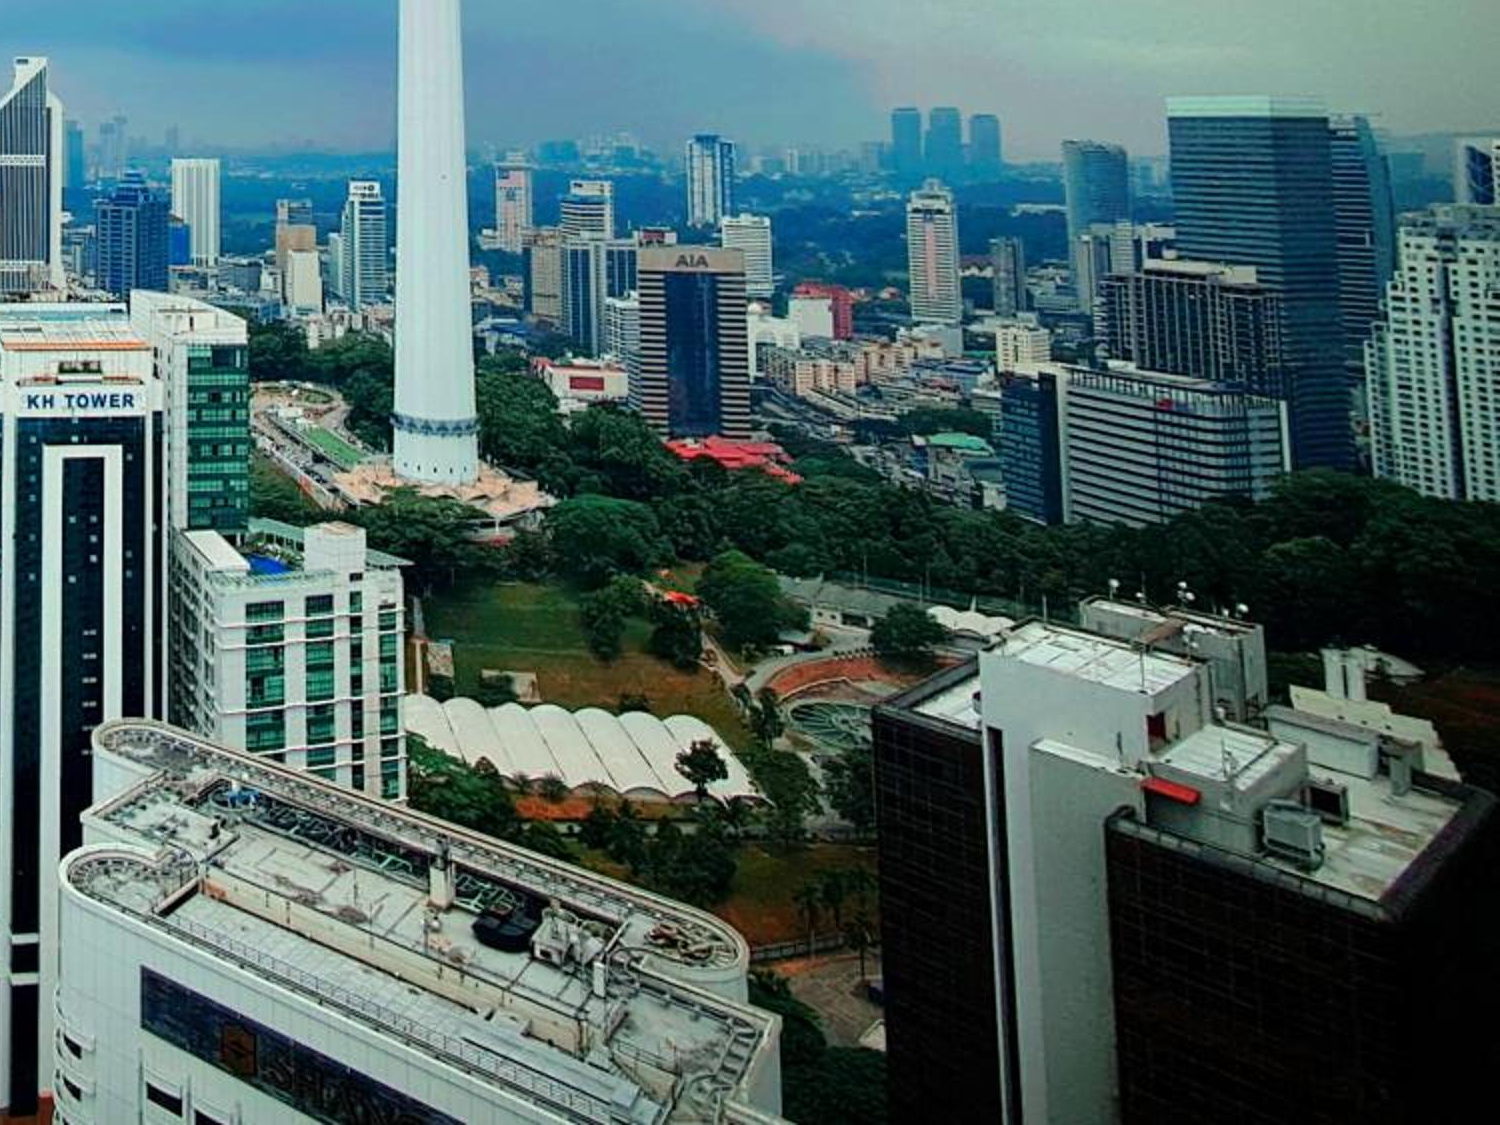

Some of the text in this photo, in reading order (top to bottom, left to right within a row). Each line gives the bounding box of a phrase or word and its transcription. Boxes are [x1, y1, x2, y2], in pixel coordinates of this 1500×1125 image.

[676, 254, 709, 268] AIA
[27, 393, 135, 410] KH TOWER
